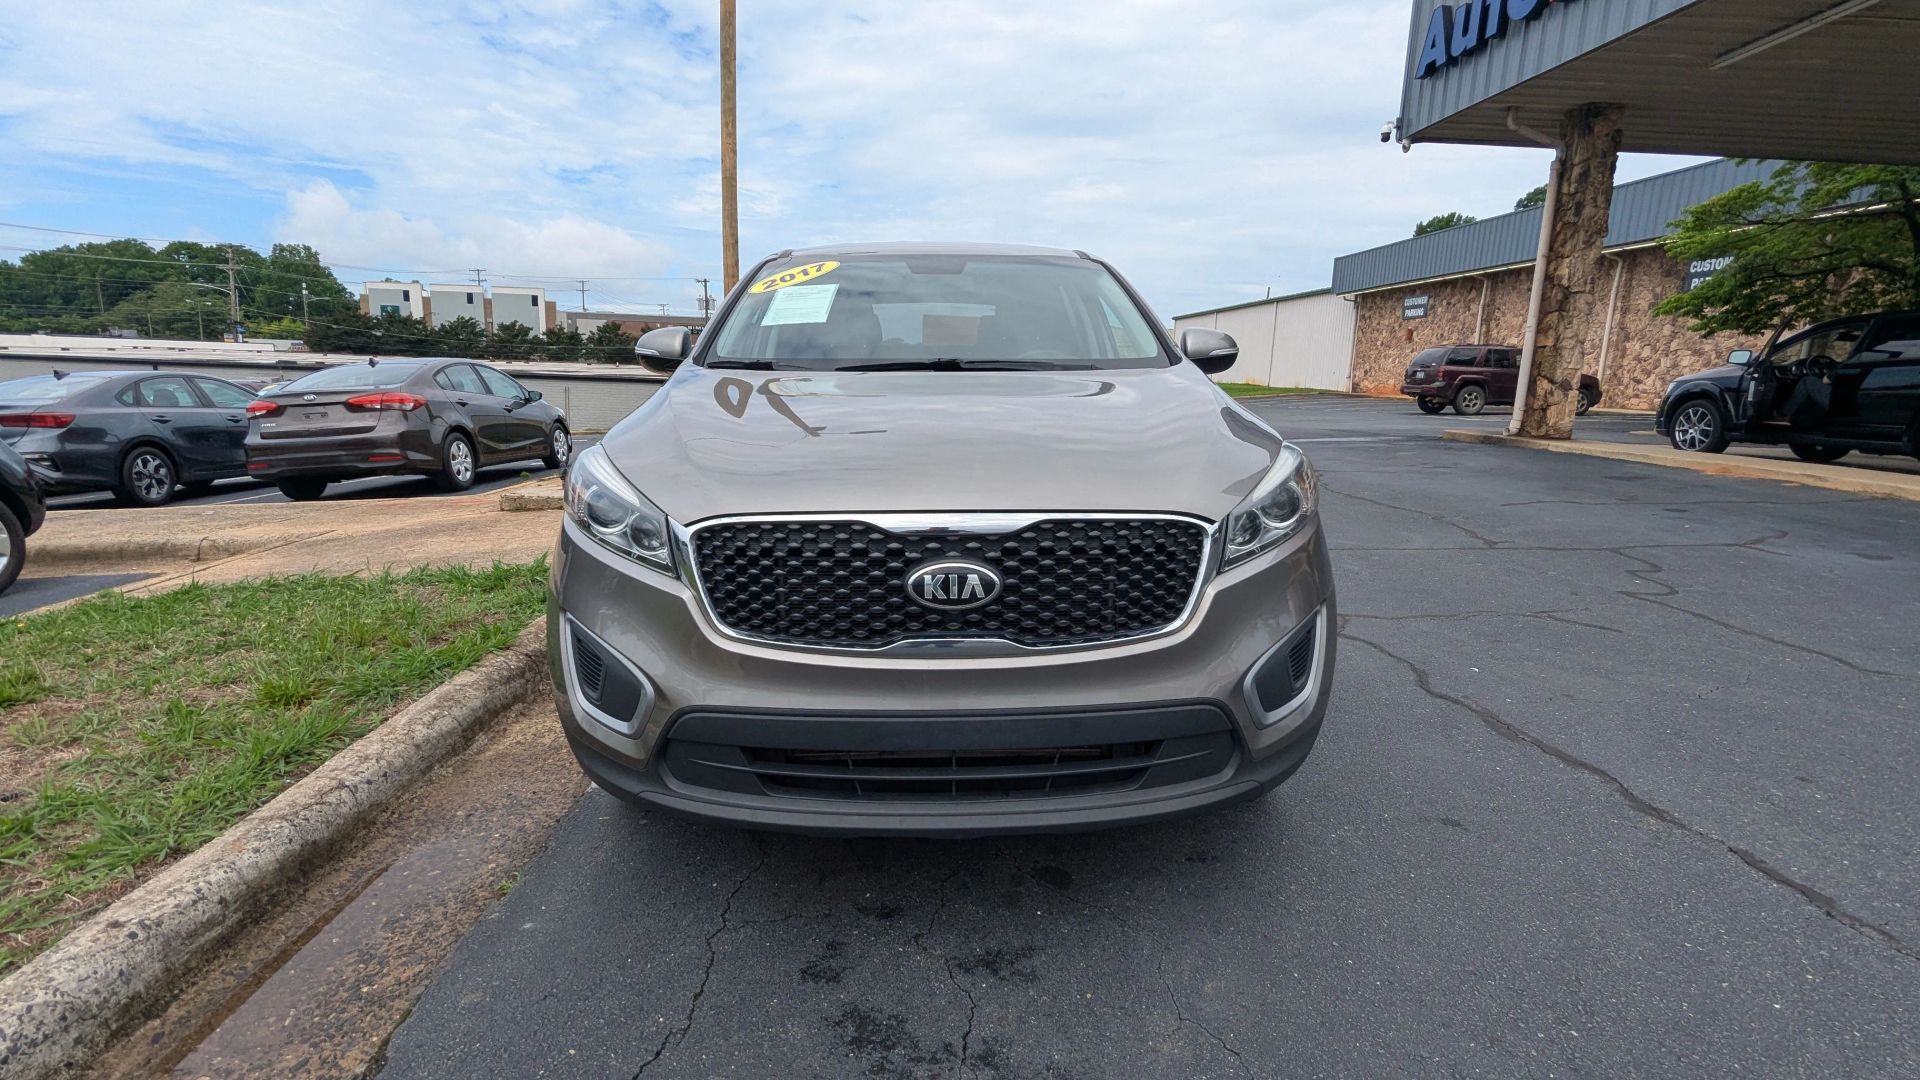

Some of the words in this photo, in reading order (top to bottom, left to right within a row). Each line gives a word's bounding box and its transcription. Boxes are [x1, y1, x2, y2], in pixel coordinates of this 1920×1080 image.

[762, 262, 826, 291] 2017
[1404, 296, 1429, 306] CUSTOMER
[1404, 307, 1425, 317] PARKING
[923, 574, 986, 599] KIA
